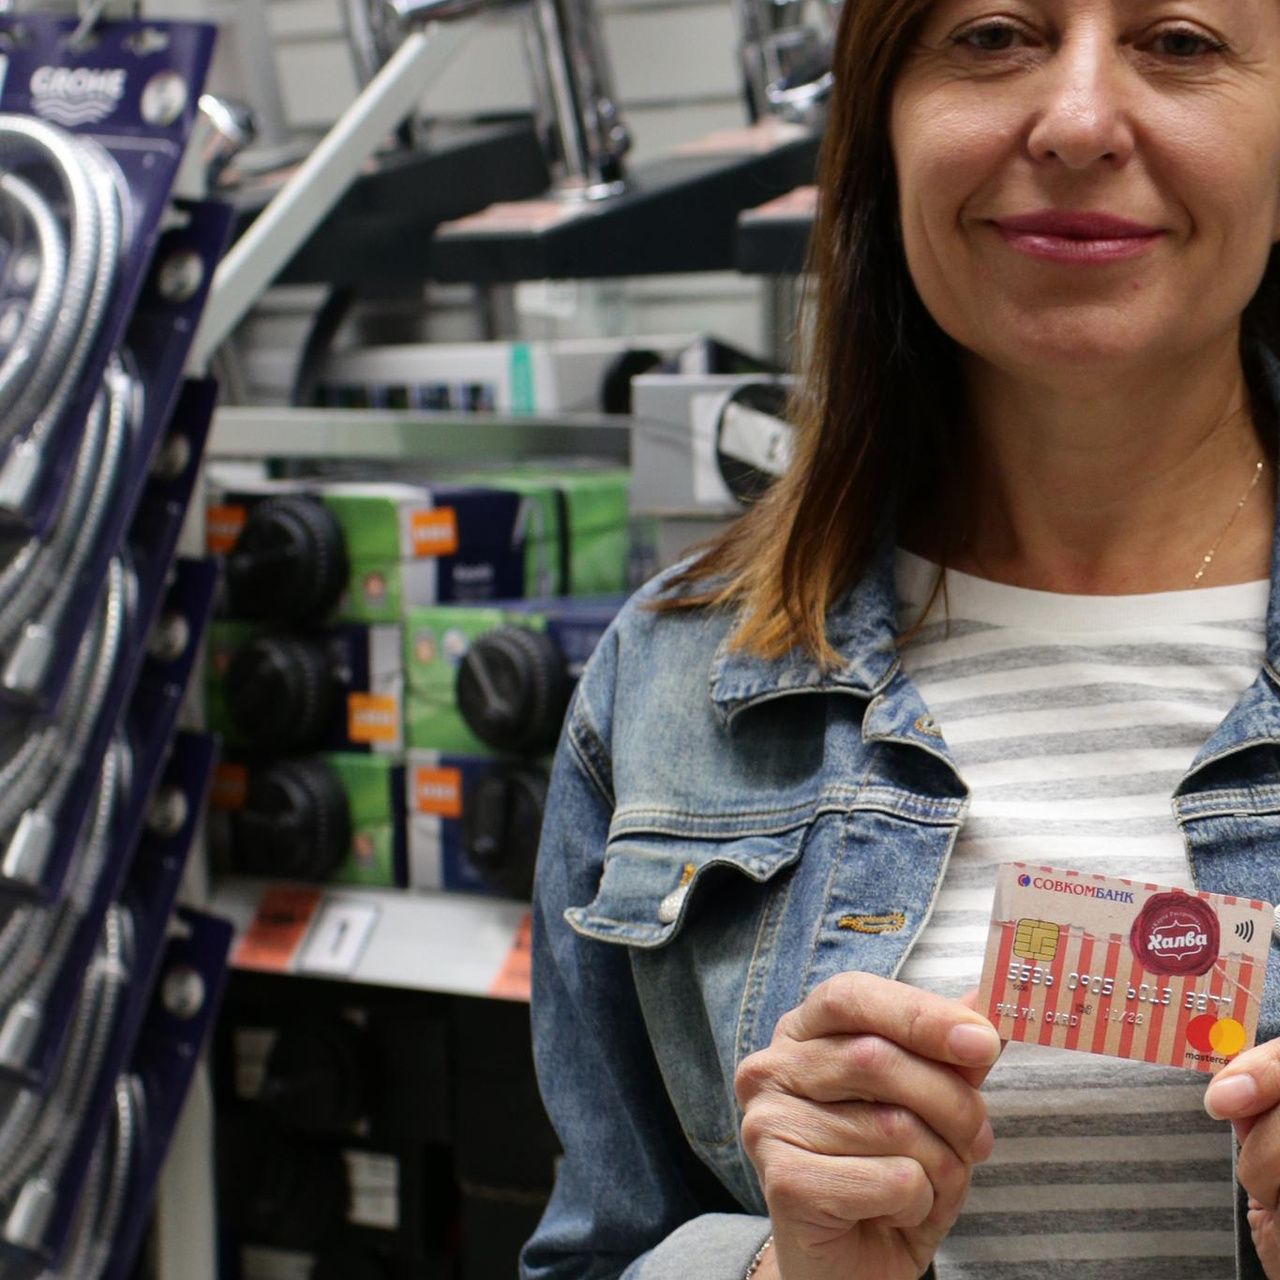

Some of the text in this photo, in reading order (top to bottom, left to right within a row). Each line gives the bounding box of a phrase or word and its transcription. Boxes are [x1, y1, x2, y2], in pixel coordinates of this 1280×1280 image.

[30, 66, 127, 98] GROHE
[1033, 877, 1134, 904] СОВКОМБАНК
[1147, 931, 1207, 950] Халва
[1185, 1051, 1233, 1066] masterca
